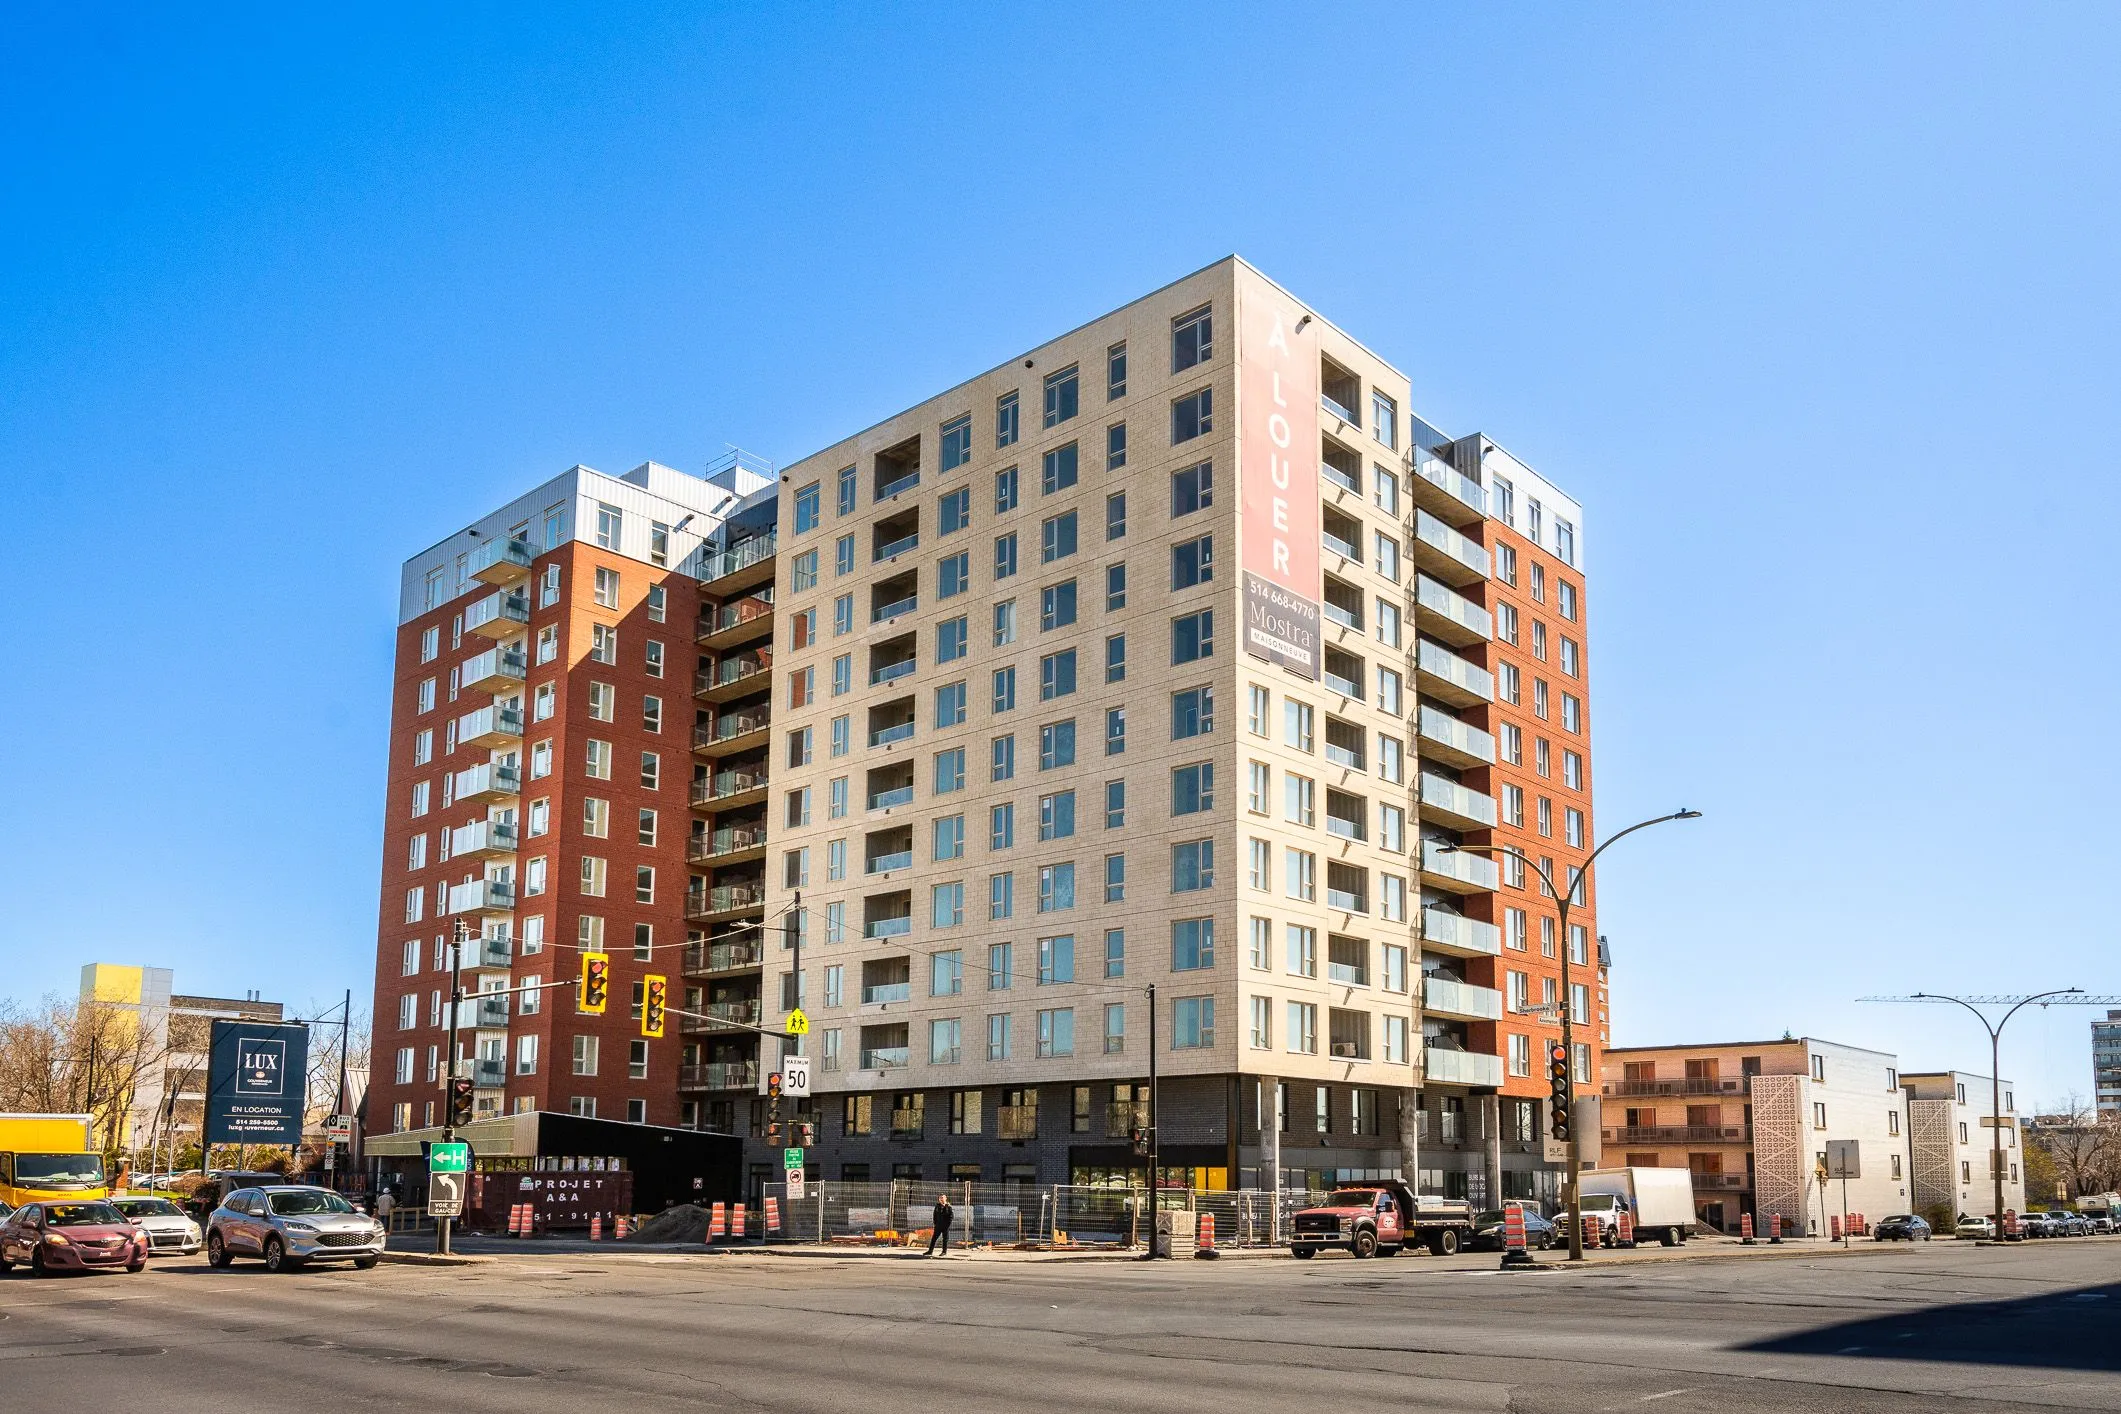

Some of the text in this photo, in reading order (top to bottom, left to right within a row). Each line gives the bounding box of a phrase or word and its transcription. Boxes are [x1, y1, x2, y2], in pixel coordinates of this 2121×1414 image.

[1268, 370, 1291, 577] LOUER
[1250, 580, 1314, 620] 514 668-4770
[1250, 600, 1311, 648] Mostra
[1254, 631, 1308, 661] MAISONNEUVE
[244, 1053, 278, 1070] LUX
[788, 1070, 806, 1089] 50
[244, 1106, 282, 1114] LOCATION
[452, 1149, 465, 1166] H
